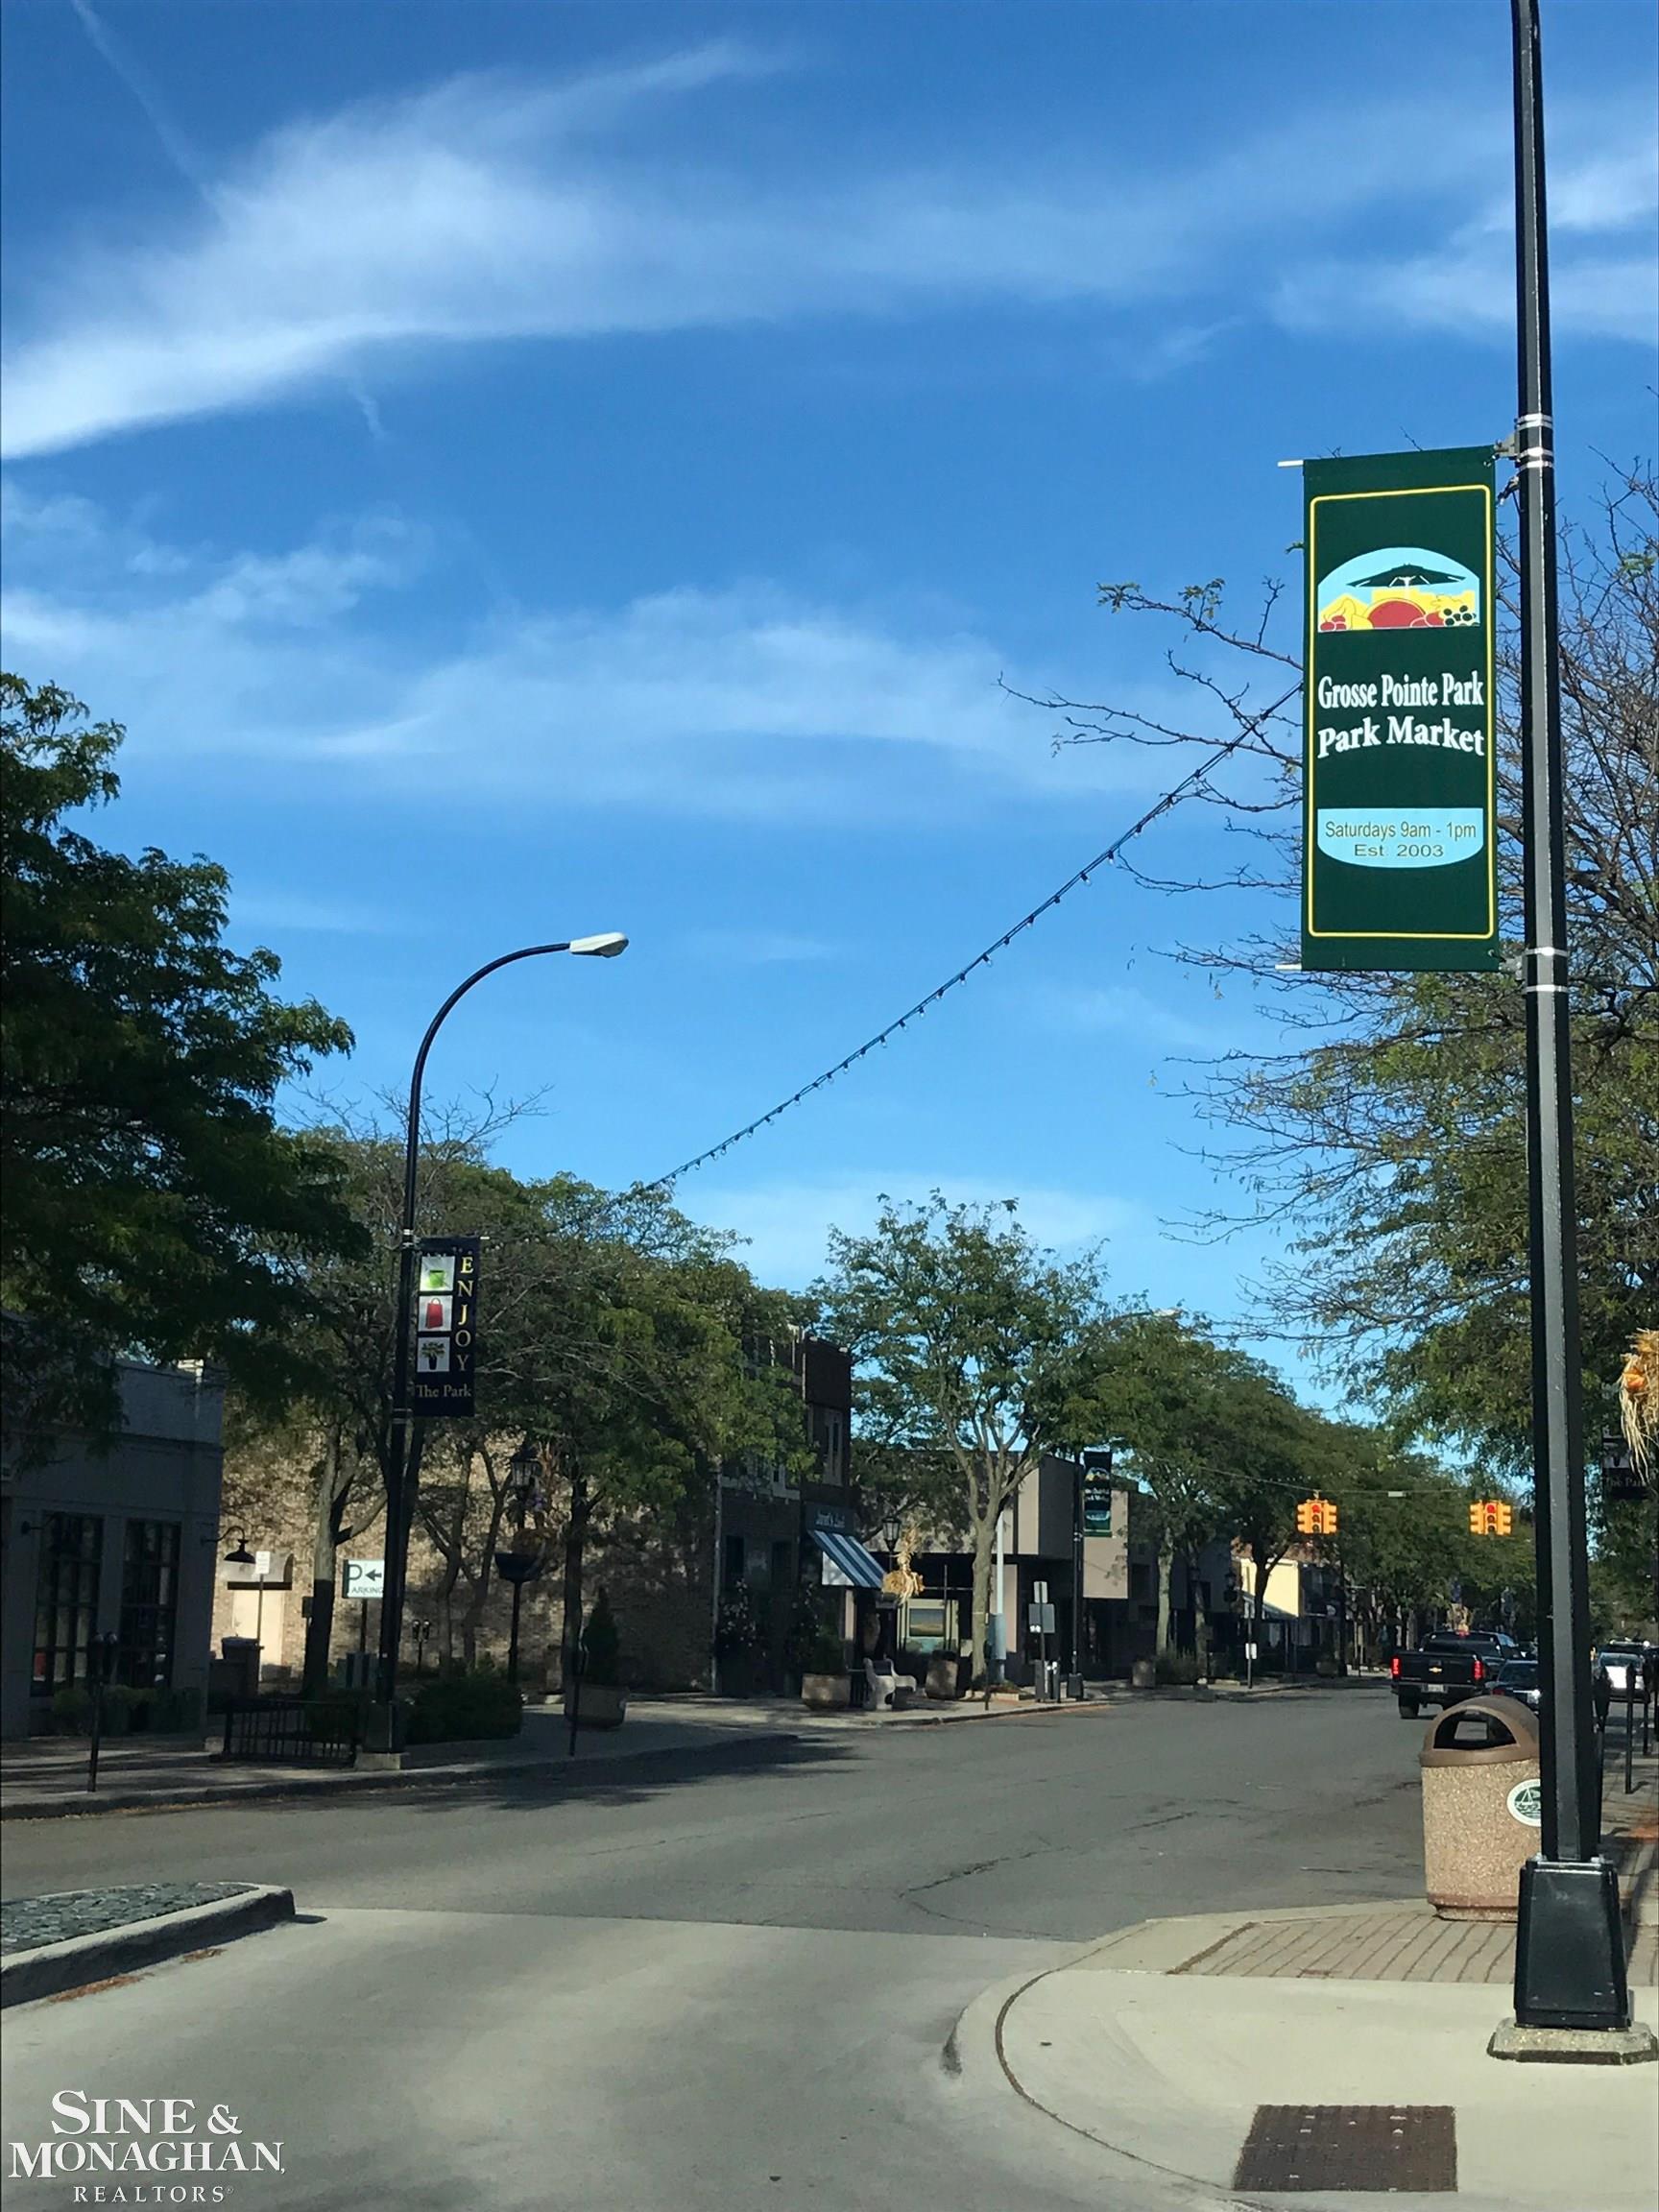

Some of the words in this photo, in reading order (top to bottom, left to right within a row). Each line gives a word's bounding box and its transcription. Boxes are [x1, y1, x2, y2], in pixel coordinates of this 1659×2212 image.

[1317, 675, 1378, 709] Grosse
[1381, 673, 1438, 708] Pointe
[1441, 670, 1484, 706] Park
[1317, 716, 1382, 758] Park
[1385, 715, 1485, 757] Market
[1325, 821, 1396, 842] Saturdays
[1400, 821, 1431, 838] 9am
[1446, 822, 1477, 842] 1pm
[1396, 844, 1445, 857] 2003
[455, 1256, 474, 1373] ENJOY
[416, 1384, 439, 1398] The
[443, 1383, 472, 1398] Park
